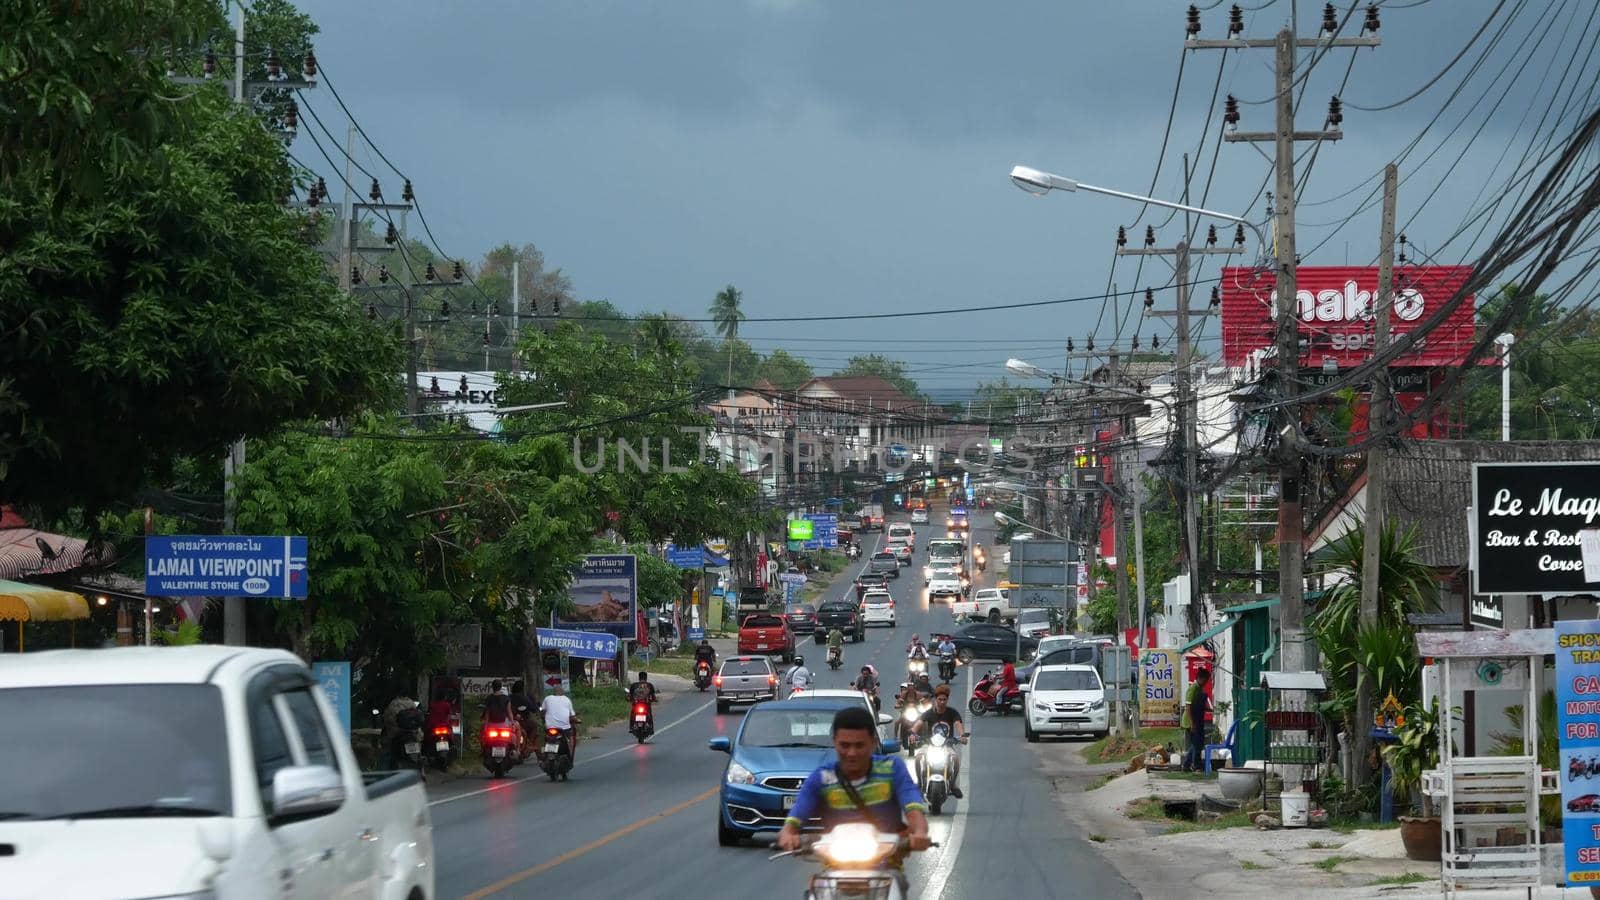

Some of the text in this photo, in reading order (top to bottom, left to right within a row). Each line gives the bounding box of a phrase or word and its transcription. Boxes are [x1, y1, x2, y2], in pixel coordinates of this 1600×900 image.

[1488, 488, 1523, 516] Le
[1485, 529, 1521, 547] Bar
[1524, 529, 1539, 547] &
[148, 558, 283, 577] LAMAI VIEWPOINT
[1538, 554, 1584, 571] Corse
[161, 581, 267, 590] VALENTINE STONE 100M
[541, 637, 592, 650] WATERFALL 2
[1566, 723, 1598, 739] FOR
[1578, 847, 1600, 864] SE
